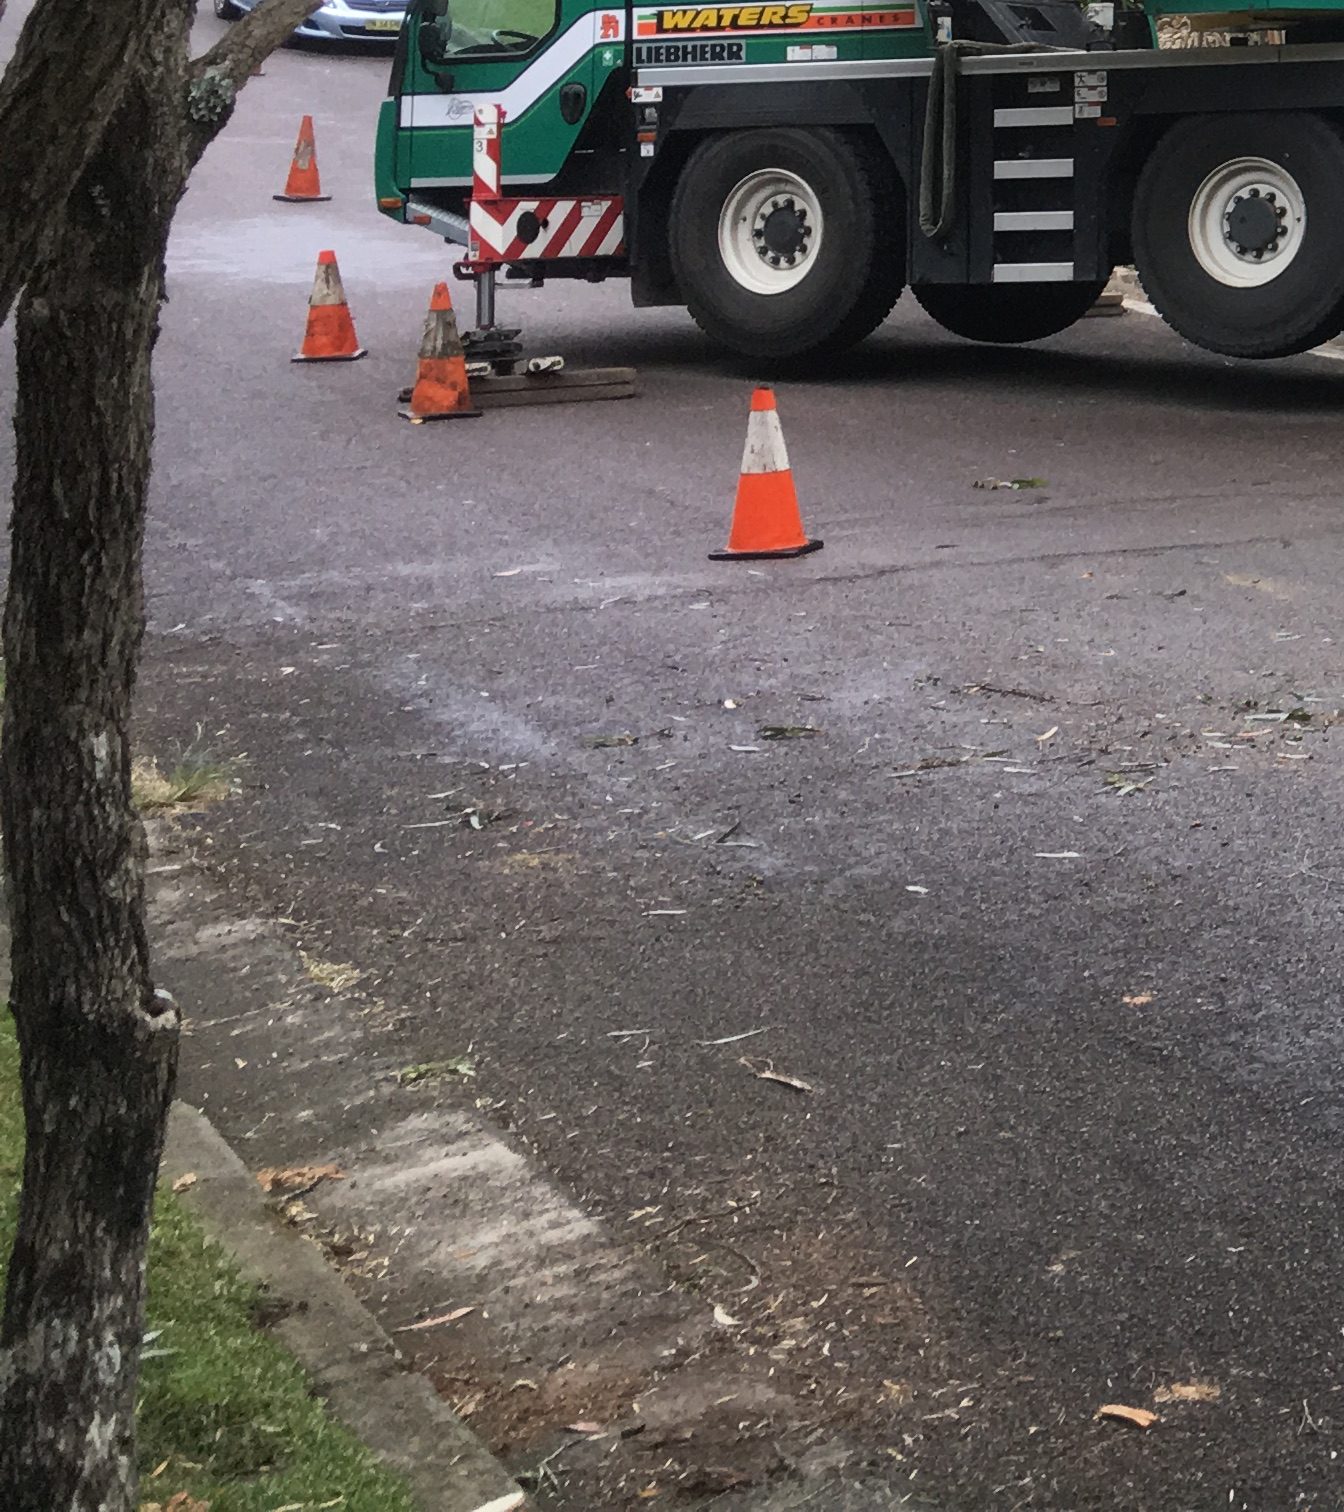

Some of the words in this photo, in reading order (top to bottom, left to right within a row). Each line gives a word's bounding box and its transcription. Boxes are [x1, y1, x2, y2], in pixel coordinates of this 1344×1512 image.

[660, 4, 813, 31] WATERS
[816, 13, 901, 26] CRANES
[635, 42, 743, 65] LIEBHERR
[475, 140, 484, 153] 3
